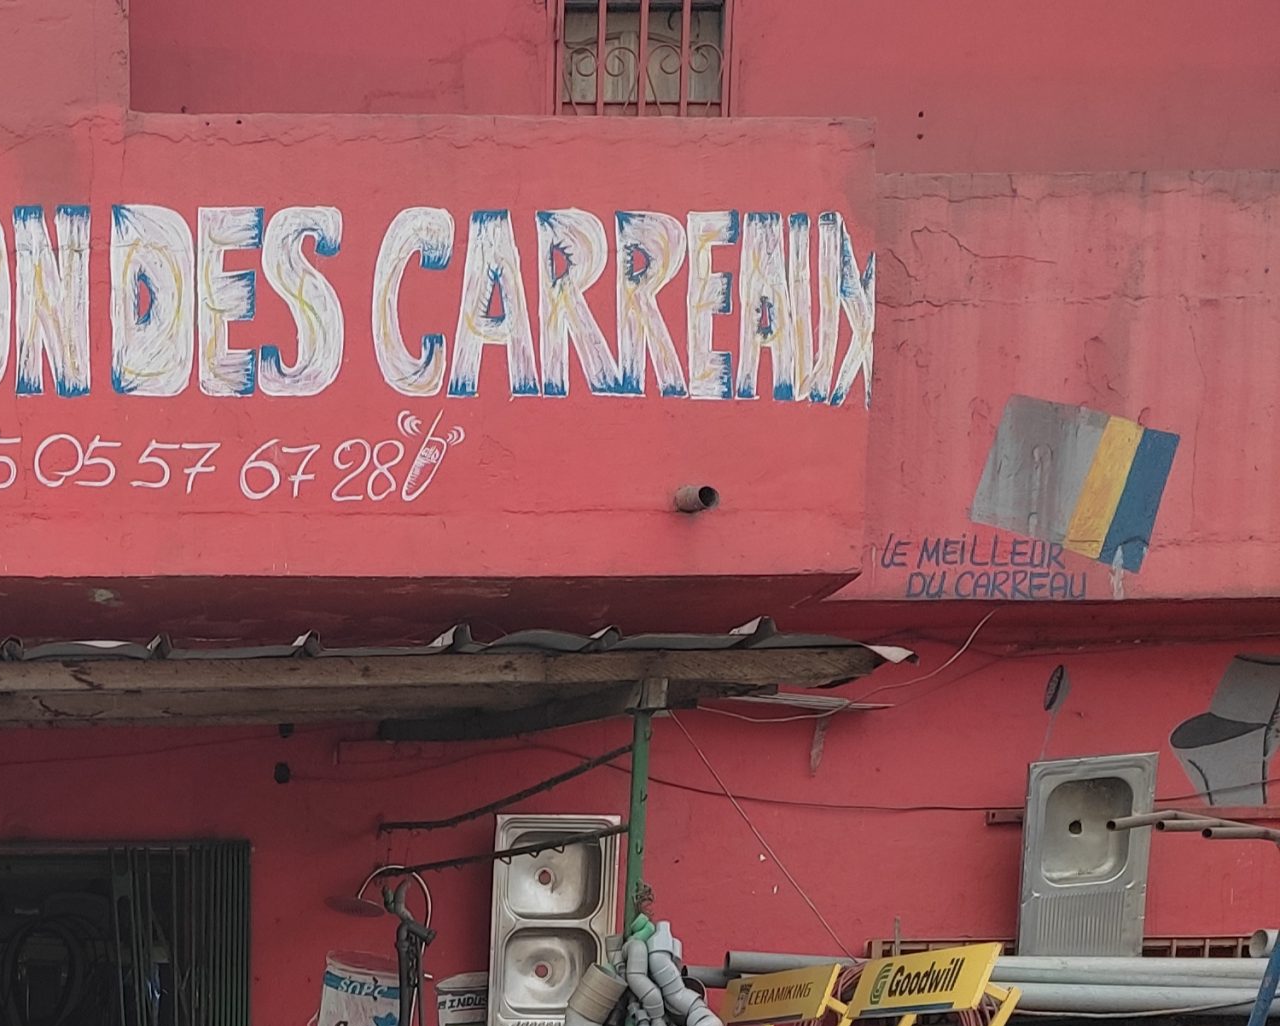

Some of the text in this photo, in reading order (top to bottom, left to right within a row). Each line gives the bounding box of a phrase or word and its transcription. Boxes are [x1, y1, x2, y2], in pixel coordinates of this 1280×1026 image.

[111, 203, 343, 397] DES
[372, 205, 876, 408] CARREAUX
[881, 533, 911, 569] LE
[905, 570, 1087, 599] DU CARREAU
[747, 981, 815, 1006] CERAMIKING
[887, 957, 966, 997] Goodwill
